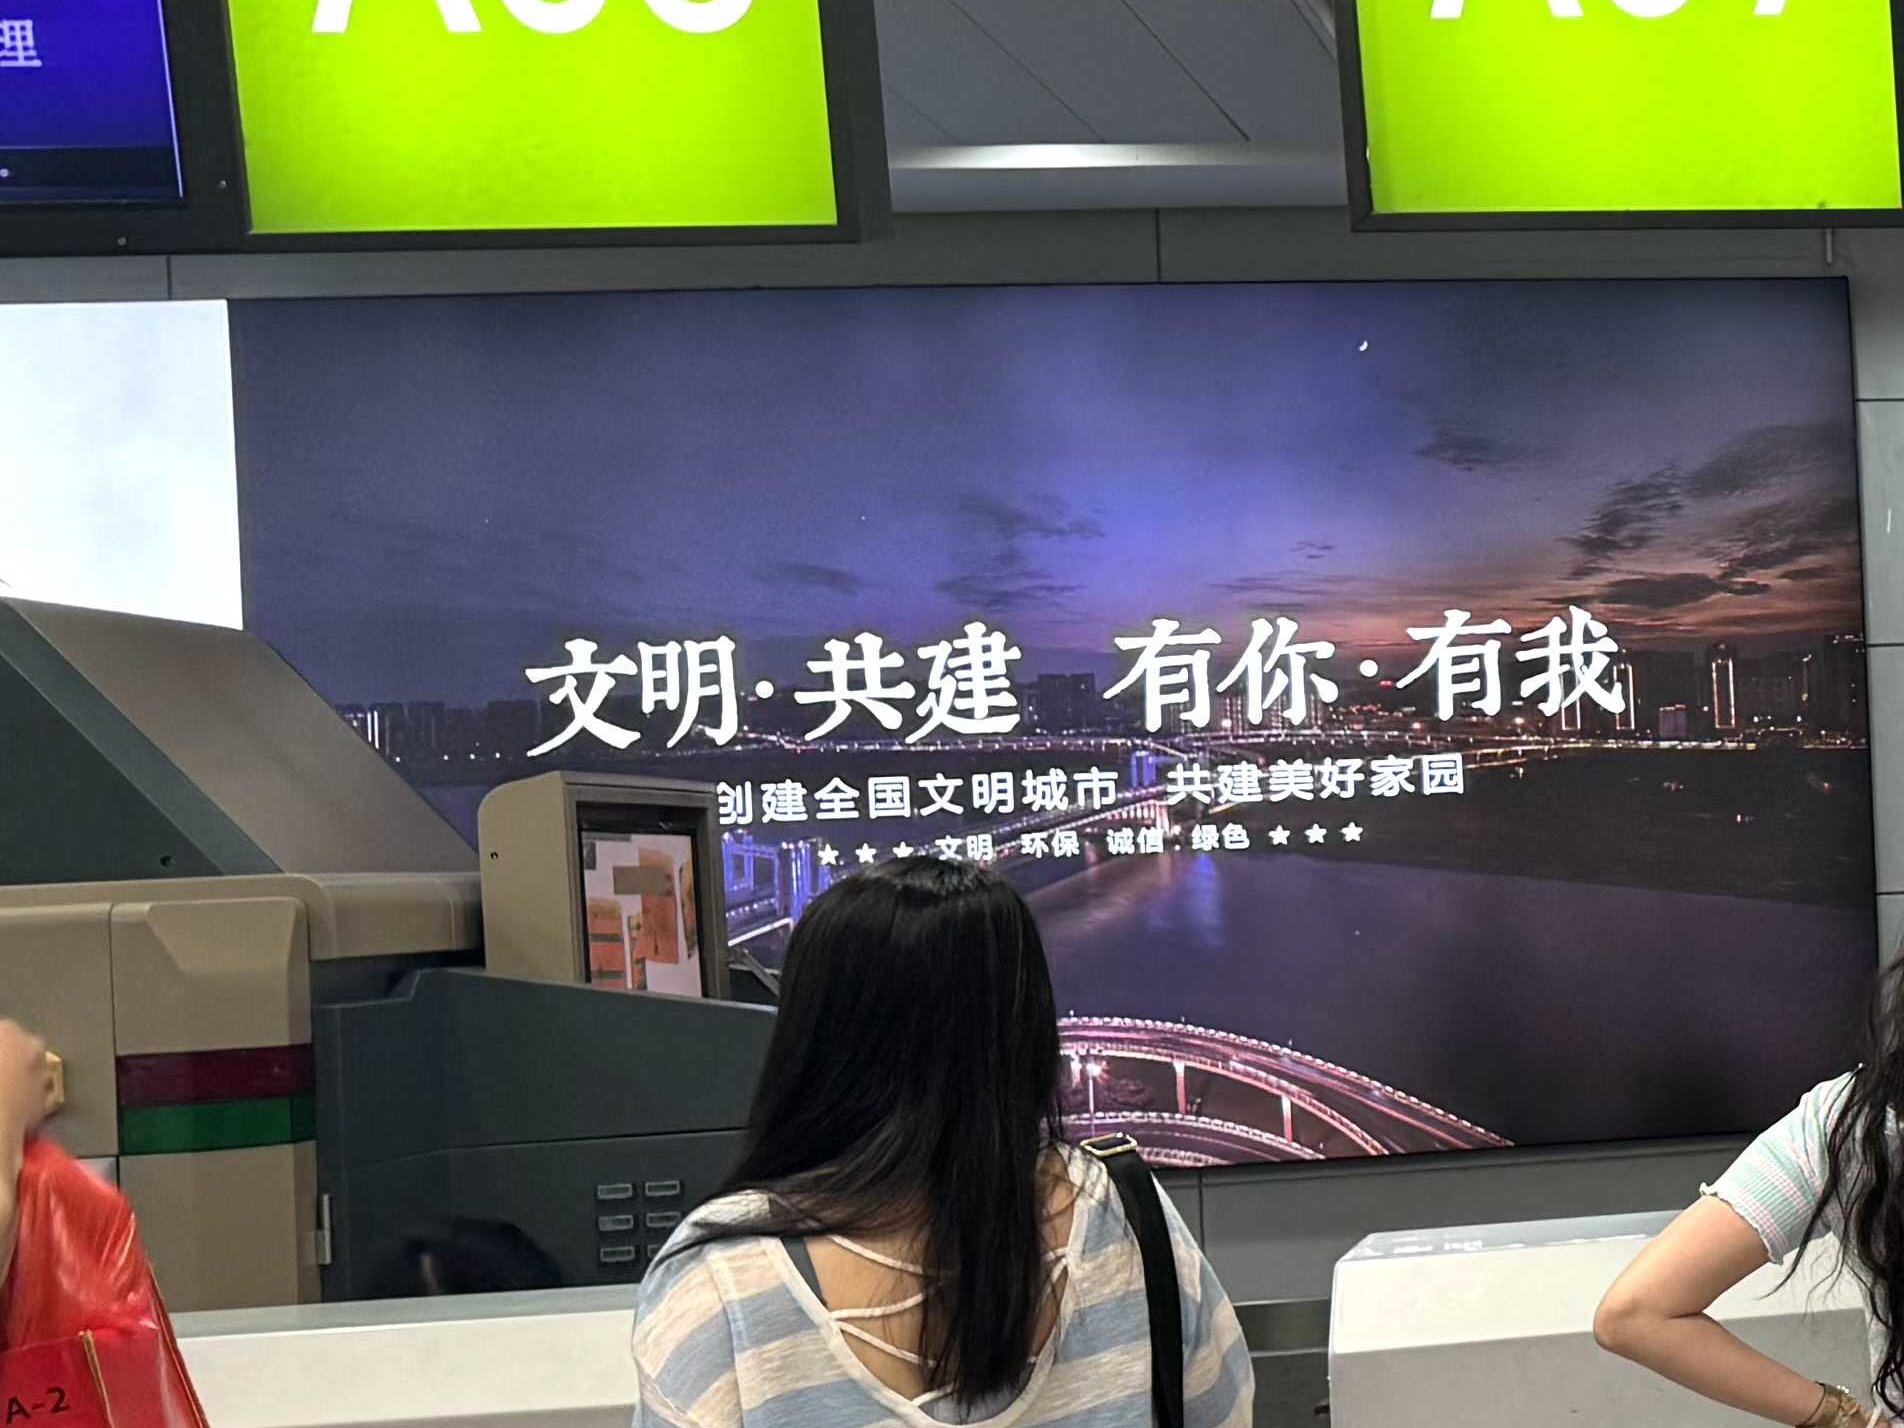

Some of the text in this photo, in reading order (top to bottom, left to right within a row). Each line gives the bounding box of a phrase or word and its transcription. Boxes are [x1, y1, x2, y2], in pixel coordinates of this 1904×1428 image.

[716, 753, 1467, 827] 创建全国文明城市 共建美好家园
